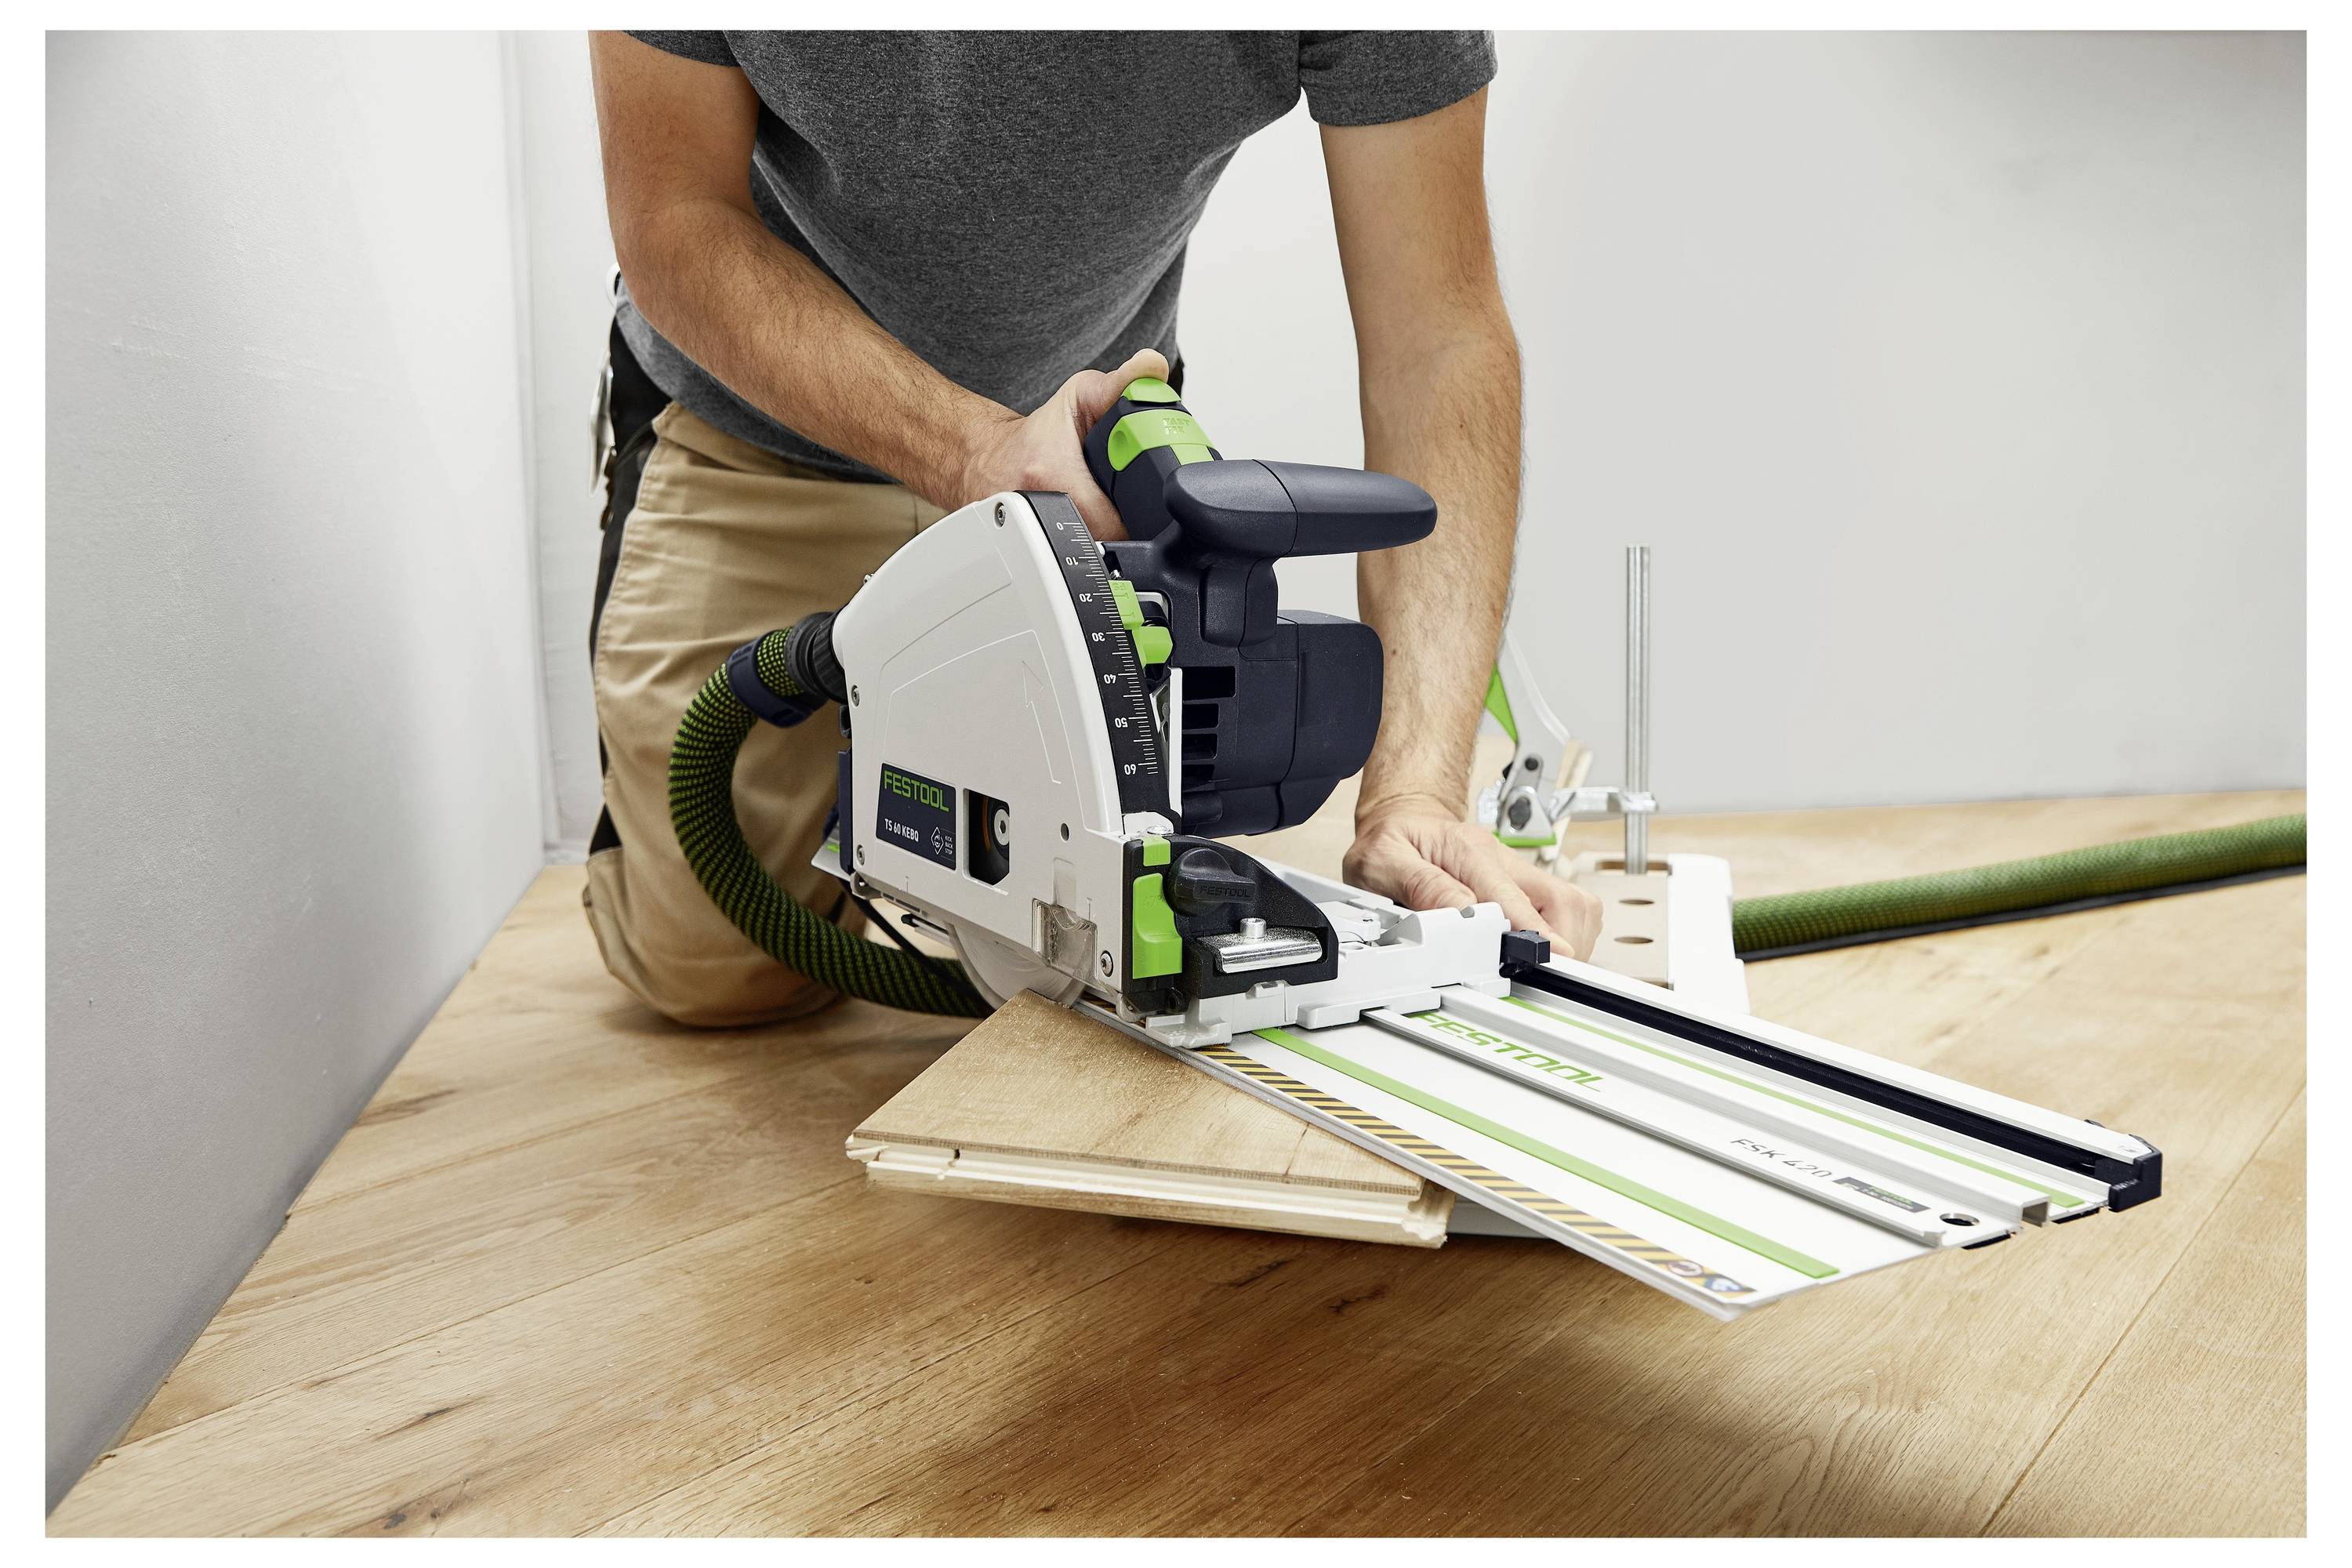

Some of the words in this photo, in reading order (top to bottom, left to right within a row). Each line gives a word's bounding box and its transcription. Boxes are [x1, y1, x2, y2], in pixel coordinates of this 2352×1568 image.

[1056, 521, 1064, 530] 0
[1066, 557, 1079, 566] 10
[1079, 593, 1093, 603] 20
[1091, 632, 1105, 642] 30
[1104, 673, 1116, 684] 40
[1114, 717, 1128, 728] 50
[1124, 764, 1137, 775] 60
[884, 770, 949, 812] FESTOOL
[884, 818, 893, 833] TS
[893, 822, 902, 836] 60
[902, 826, 919, 843] KEBQ
[1200, 885, 1250, 898] FESTOOL
[1407, 1012, 1605, 1092] FESTOOL
[1730, 1138, 1788, 1160] FSK
[1781, 1160, 1834, 1179] 420
